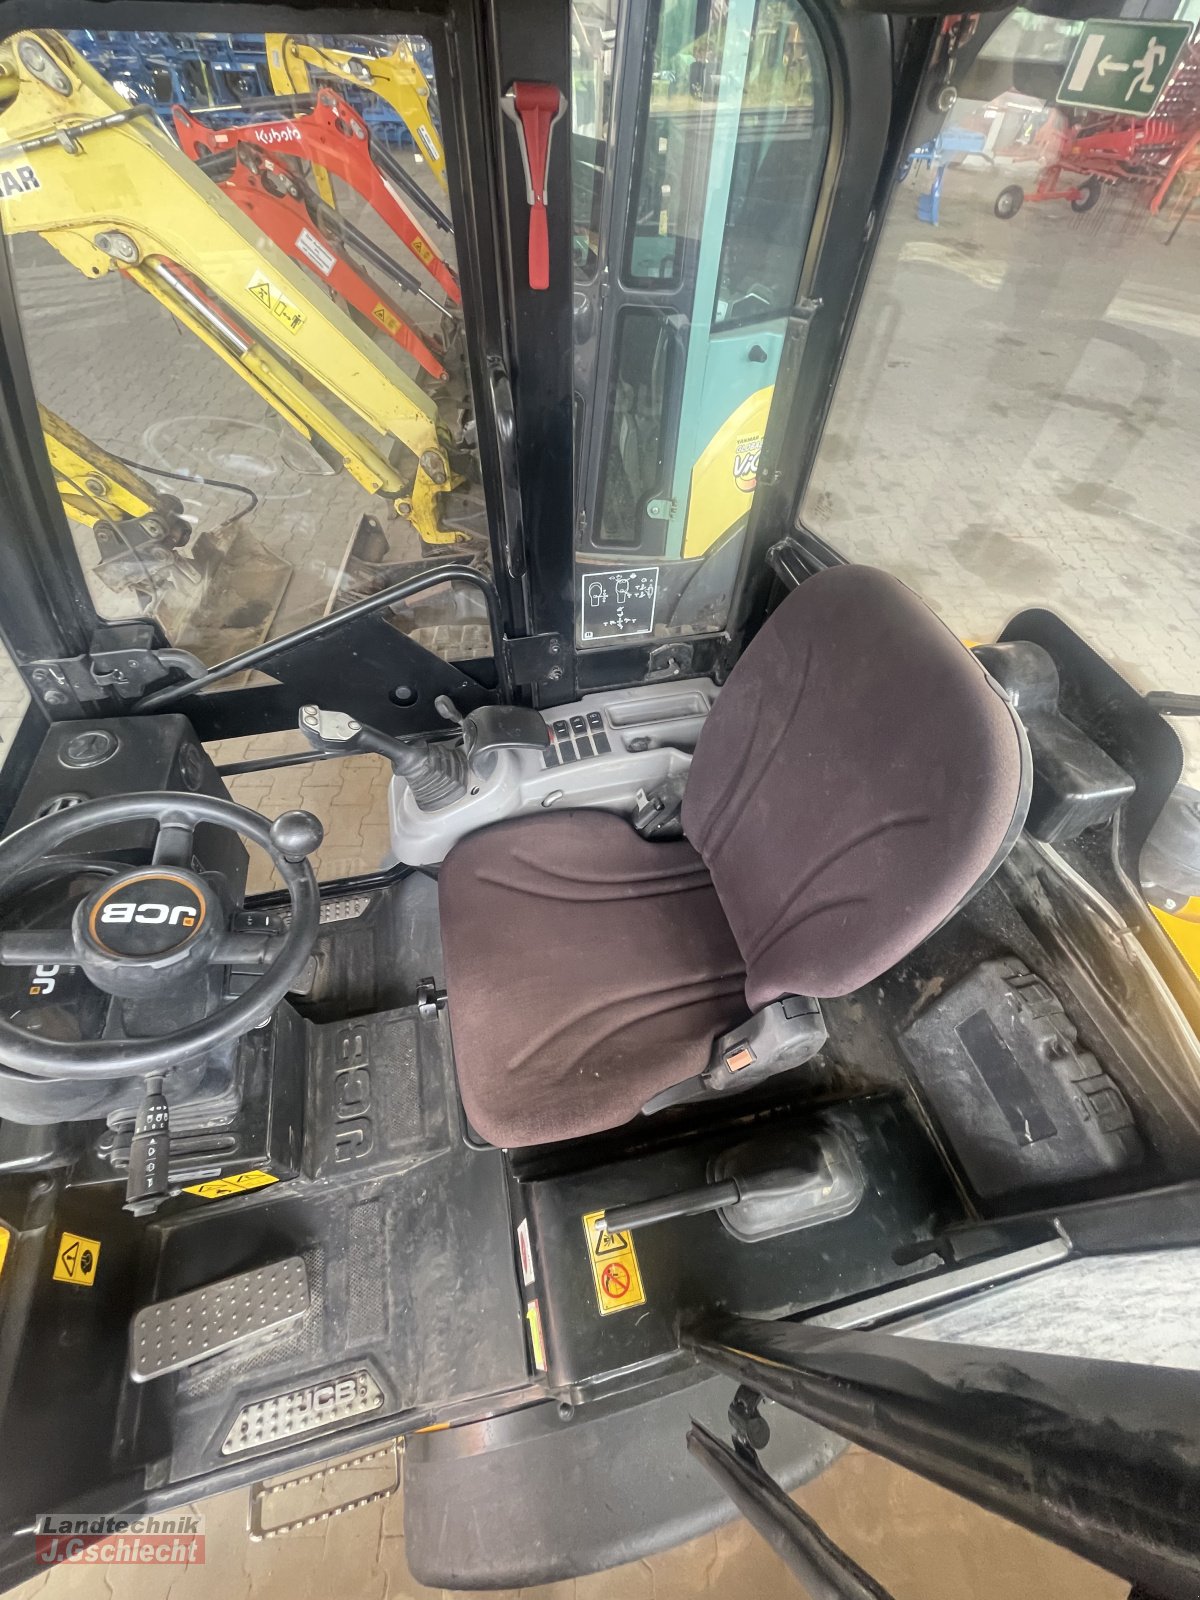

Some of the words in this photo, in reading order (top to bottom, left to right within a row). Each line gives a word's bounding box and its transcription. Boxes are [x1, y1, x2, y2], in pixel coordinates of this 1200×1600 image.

[255, 126, 302, 144] Kubota
[0, 166, 40, 197] AR
[101, 903, 197, 927] JCB
[30, 964, 60, 995] JC
[335, 1024, 373, 1163] JCB
[297, 1379, 358, 1413] JCB
